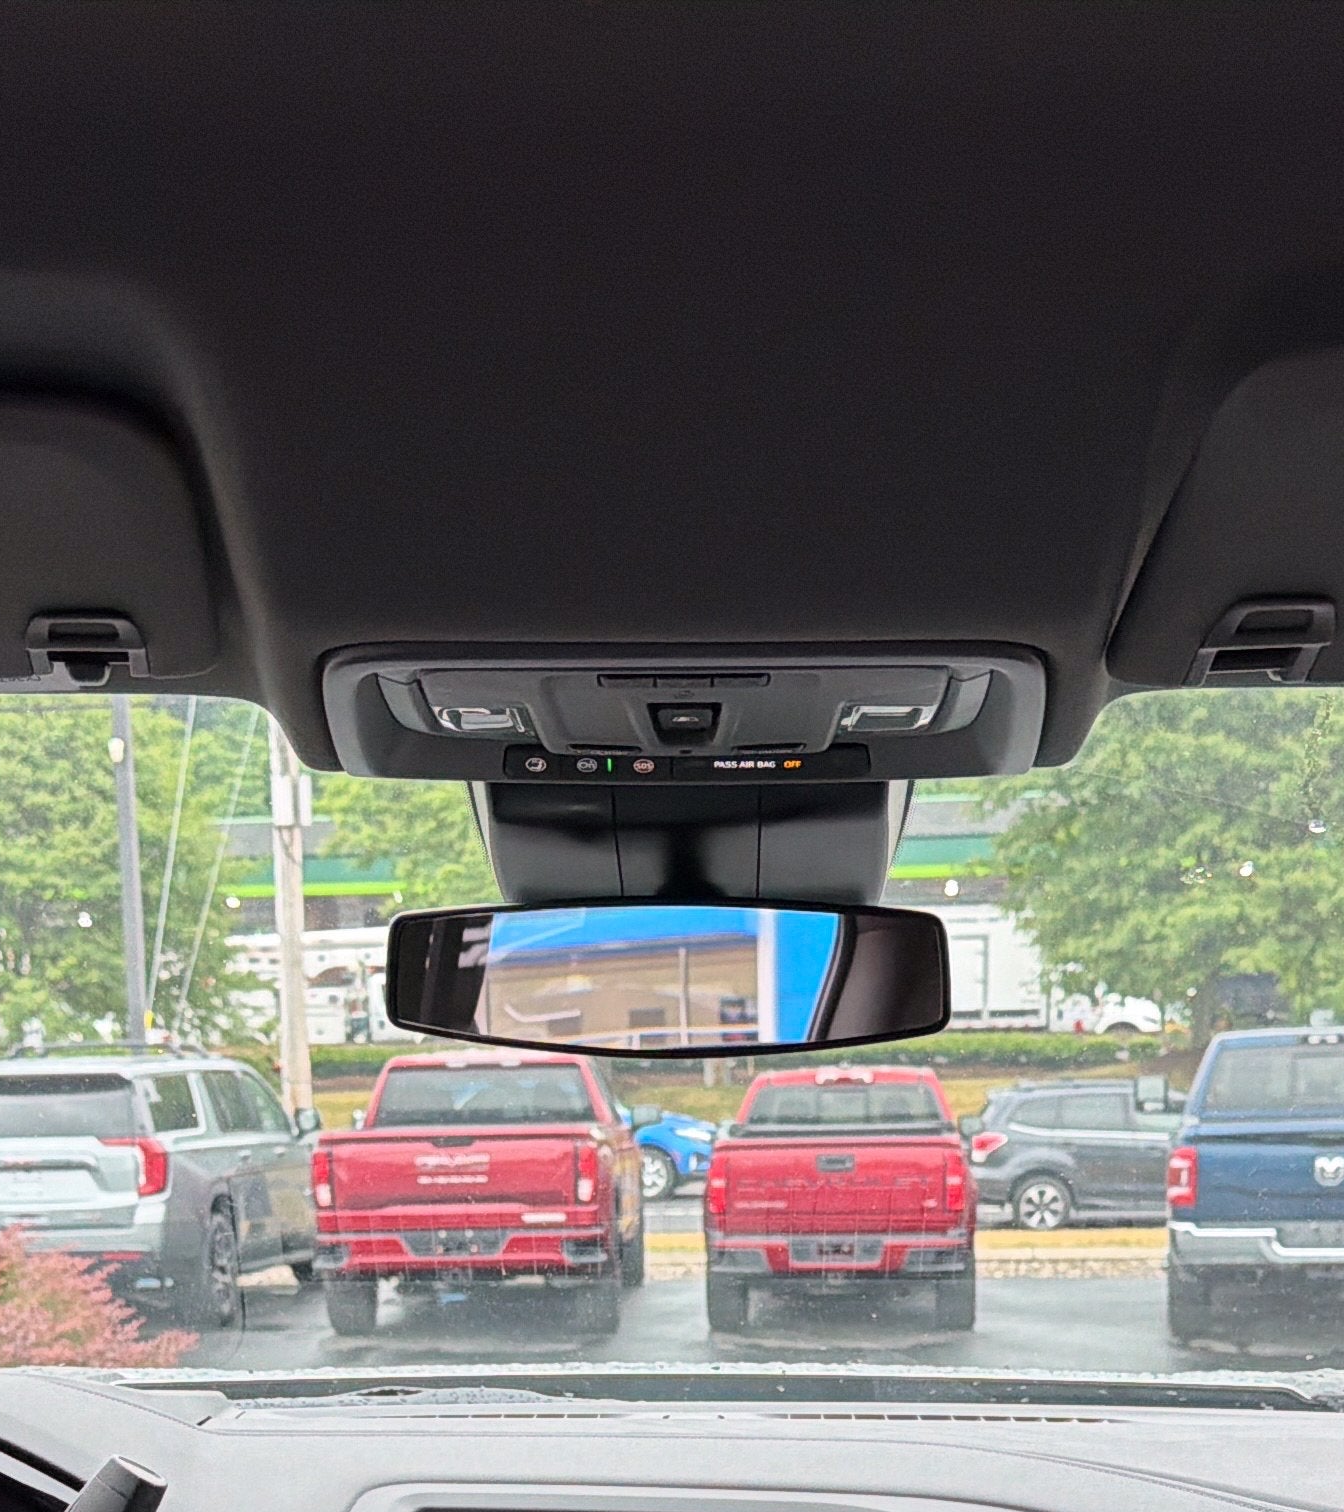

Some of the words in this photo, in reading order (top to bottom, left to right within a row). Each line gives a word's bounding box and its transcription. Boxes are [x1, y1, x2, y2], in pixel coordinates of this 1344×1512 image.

[713, 760, 737, 769] PASS
[738, 760, 754, 769] AIR
[757, 760, 776, 769] BAG
[783, 760, 801, 769] OFF
